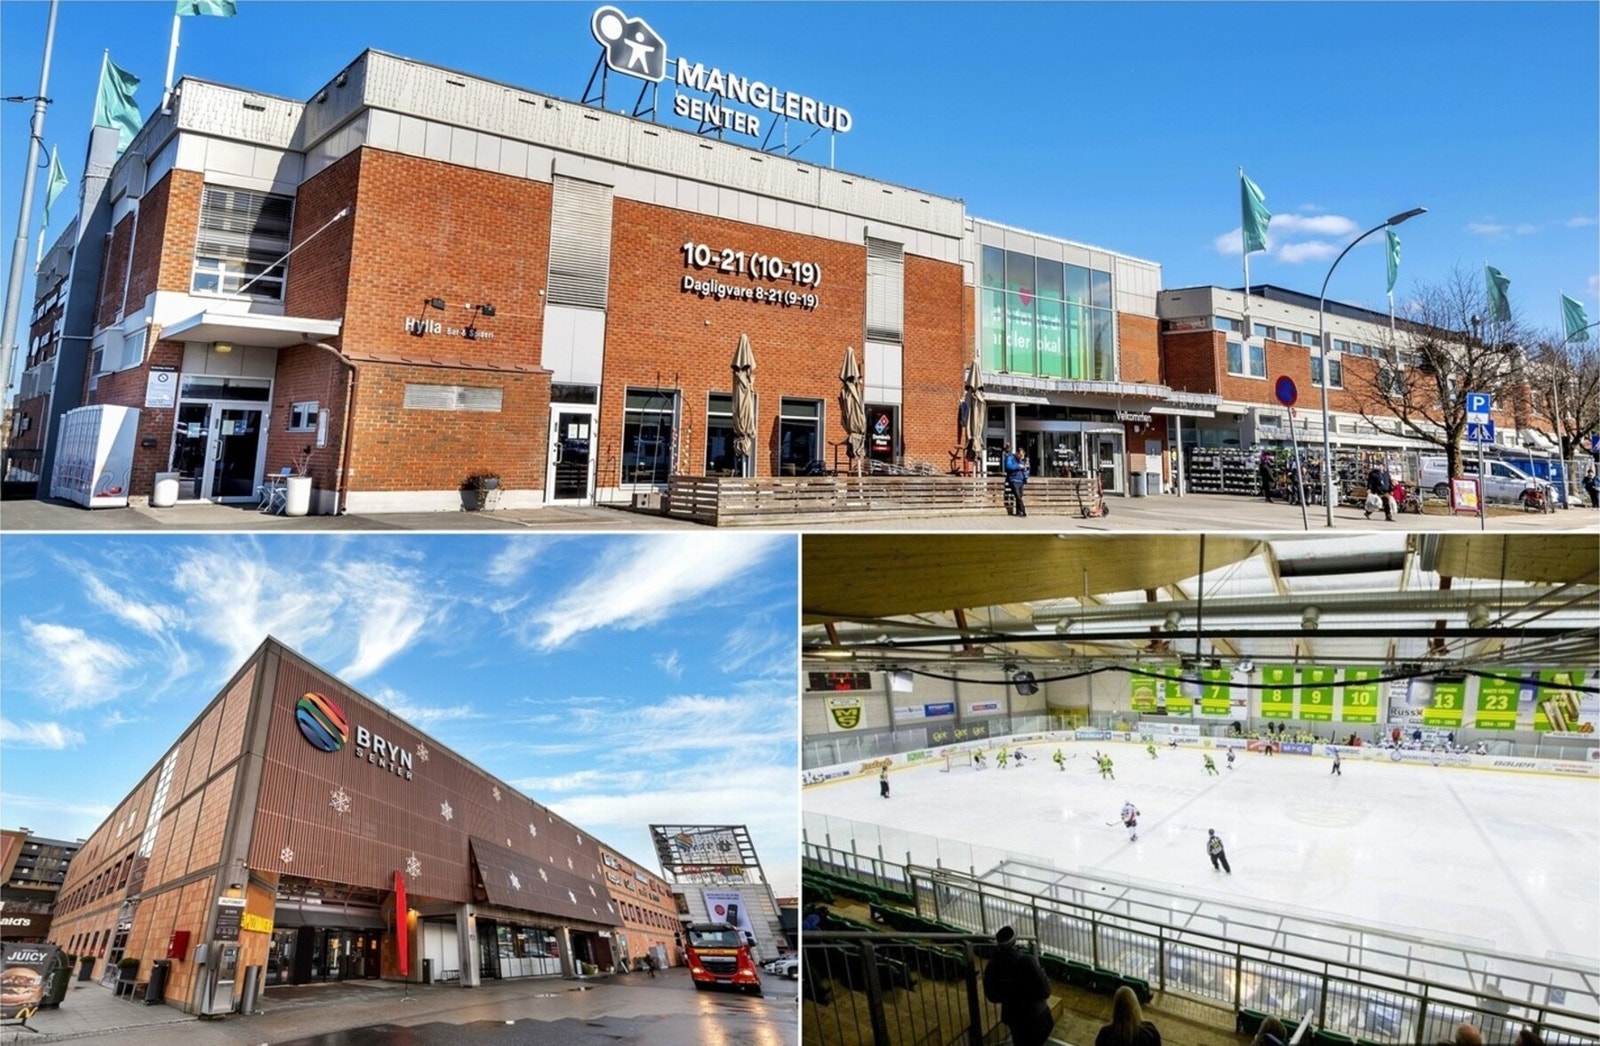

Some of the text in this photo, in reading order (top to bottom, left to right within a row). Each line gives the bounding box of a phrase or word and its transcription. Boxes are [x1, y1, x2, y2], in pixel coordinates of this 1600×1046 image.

[676, 57, 852, 133] MANGLERUD
[674, 94, 760, 137] SENTER
[682, 241, 822, 288] 10-21 (10-19)
[683, 275, 819, 309] Dagligvare 8-21 (9-19)
[404, 316, 442, 334] Hylla
[1472, 396, 1485, 411] P
[1115, 410, 1153, 422] Velkommen
[1272, 690, 1282, 702] 8
[1311, 690, 1321, 704] 9
[1351, 691, 1370, 706] 10
[1433, 693, 1455, 709] 13
[1485, 694, 1509, 710] 23
[356, 725, 413, 771] BRYN
[355, 746, 413, 780] SENTER
[7, 951, 48, 961] JUICY
